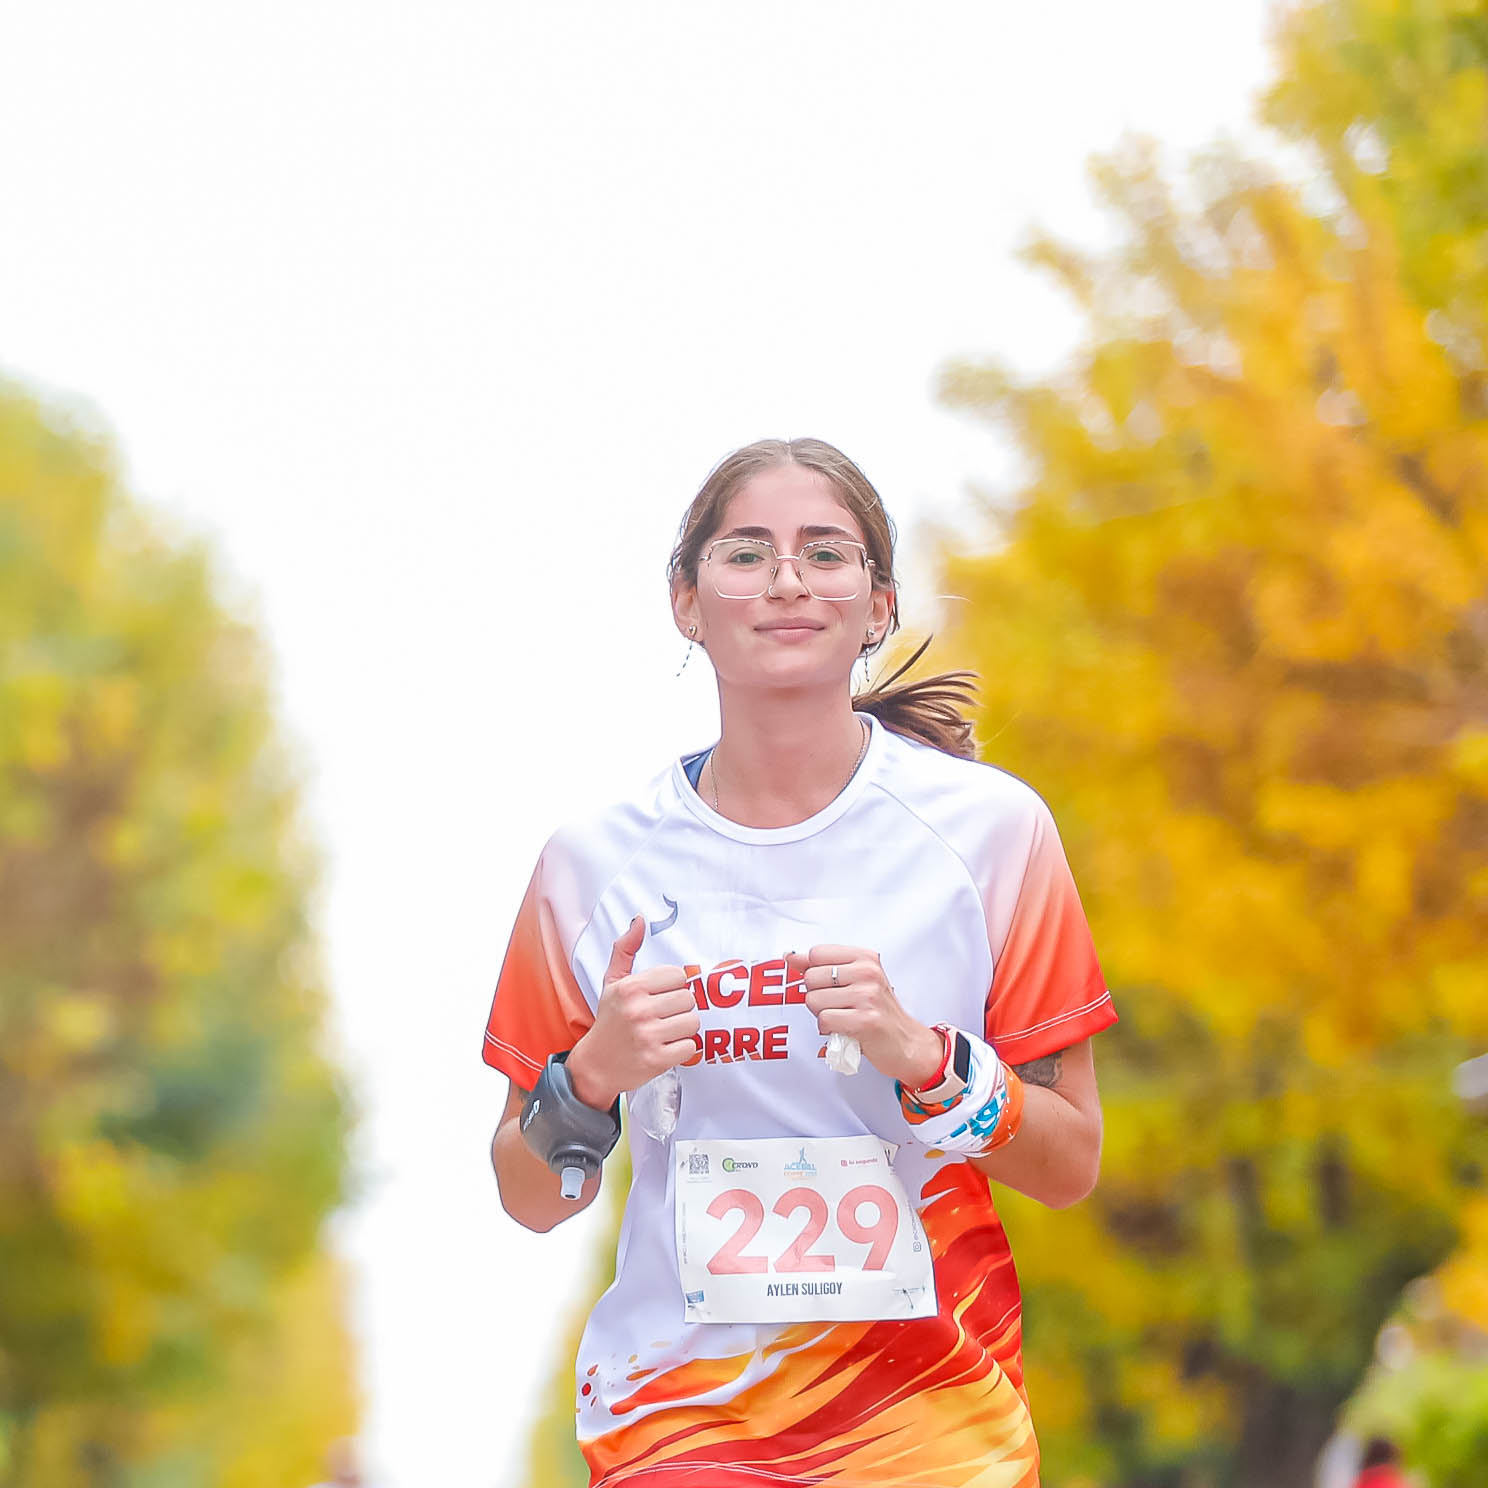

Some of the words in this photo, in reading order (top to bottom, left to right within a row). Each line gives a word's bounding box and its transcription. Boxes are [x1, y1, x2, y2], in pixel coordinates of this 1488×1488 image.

[684, 959, 807, 1010] ACE
[680, 1025, 789, 1067] RRE
[706, 1184, 899, 1275] 229
[767, 1283, 799, 1296] AYLEN
[801, 1282, 843, 1296] SULIGOY
